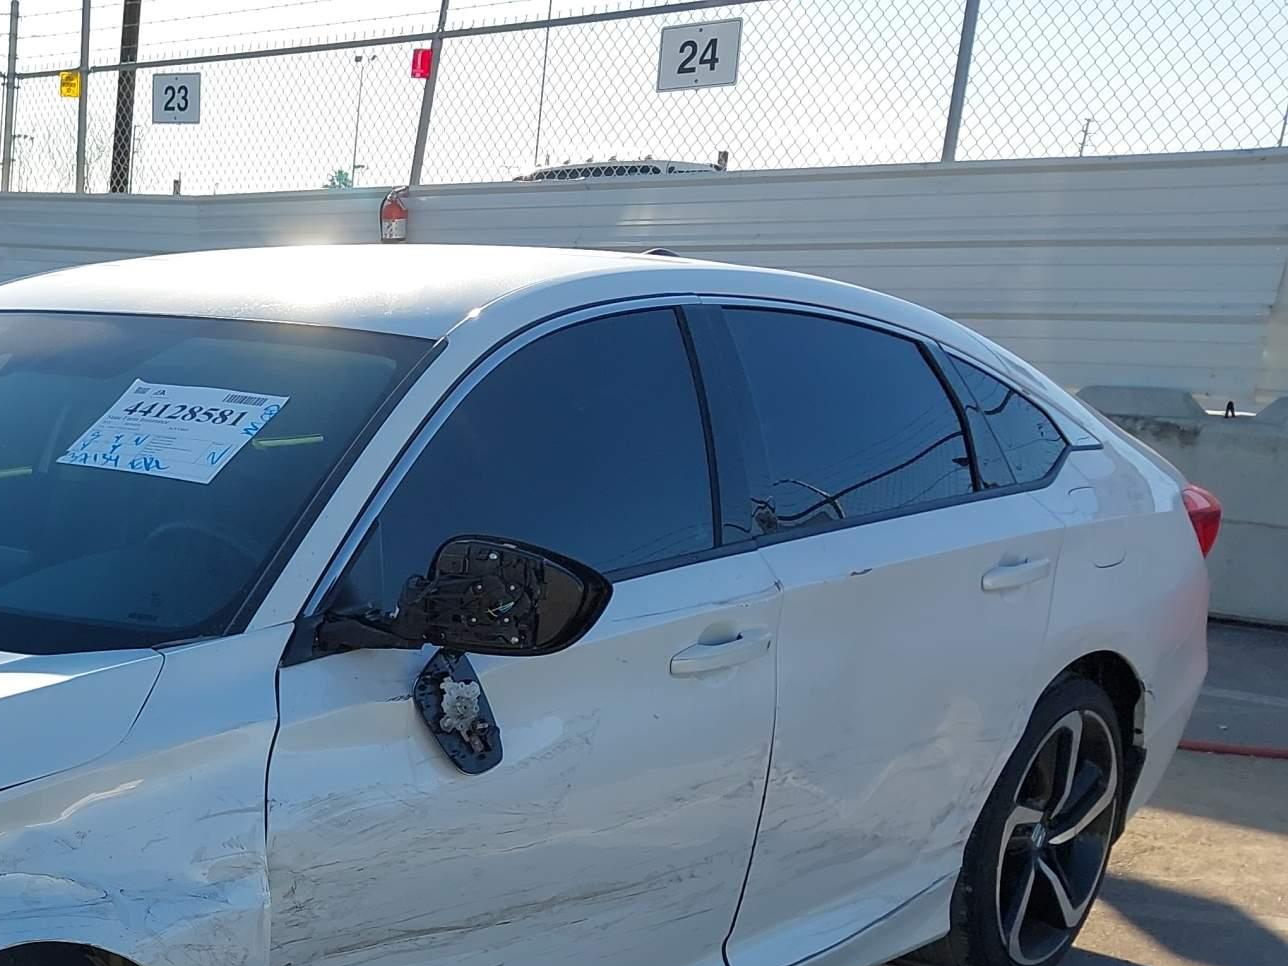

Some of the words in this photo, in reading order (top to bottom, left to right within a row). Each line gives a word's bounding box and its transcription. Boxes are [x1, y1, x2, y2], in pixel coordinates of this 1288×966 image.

[676, 37, 719, 75] 24
[163, 84, 189, 112] 23
[123, 400, 249, 427] 44128581
